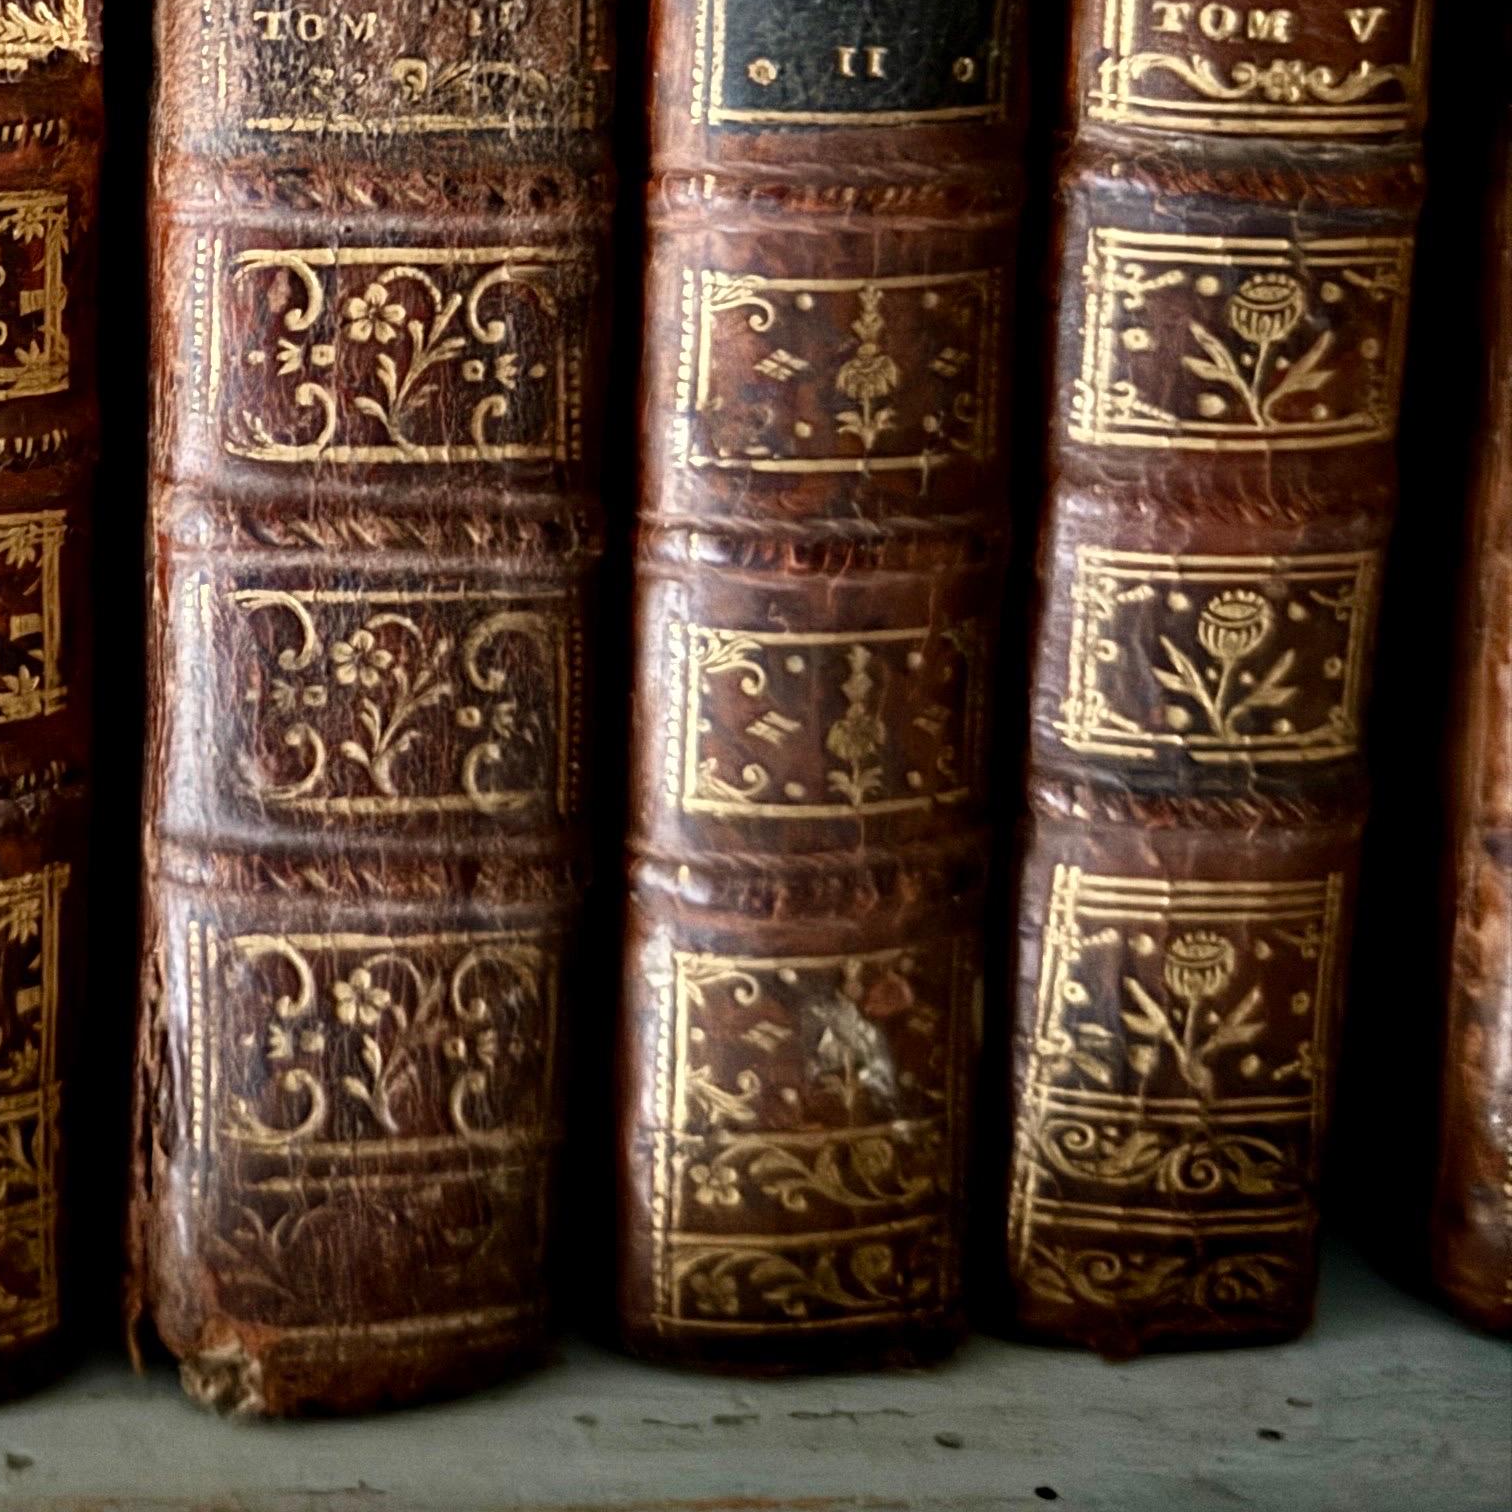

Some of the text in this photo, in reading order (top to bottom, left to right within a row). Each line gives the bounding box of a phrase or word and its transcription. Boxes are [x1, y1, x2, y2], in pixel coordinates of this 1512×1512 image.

[253, 9, 378, 43] TOM
[1345, 7, 1387, 43] V
[836, 46, 889, 79] II
